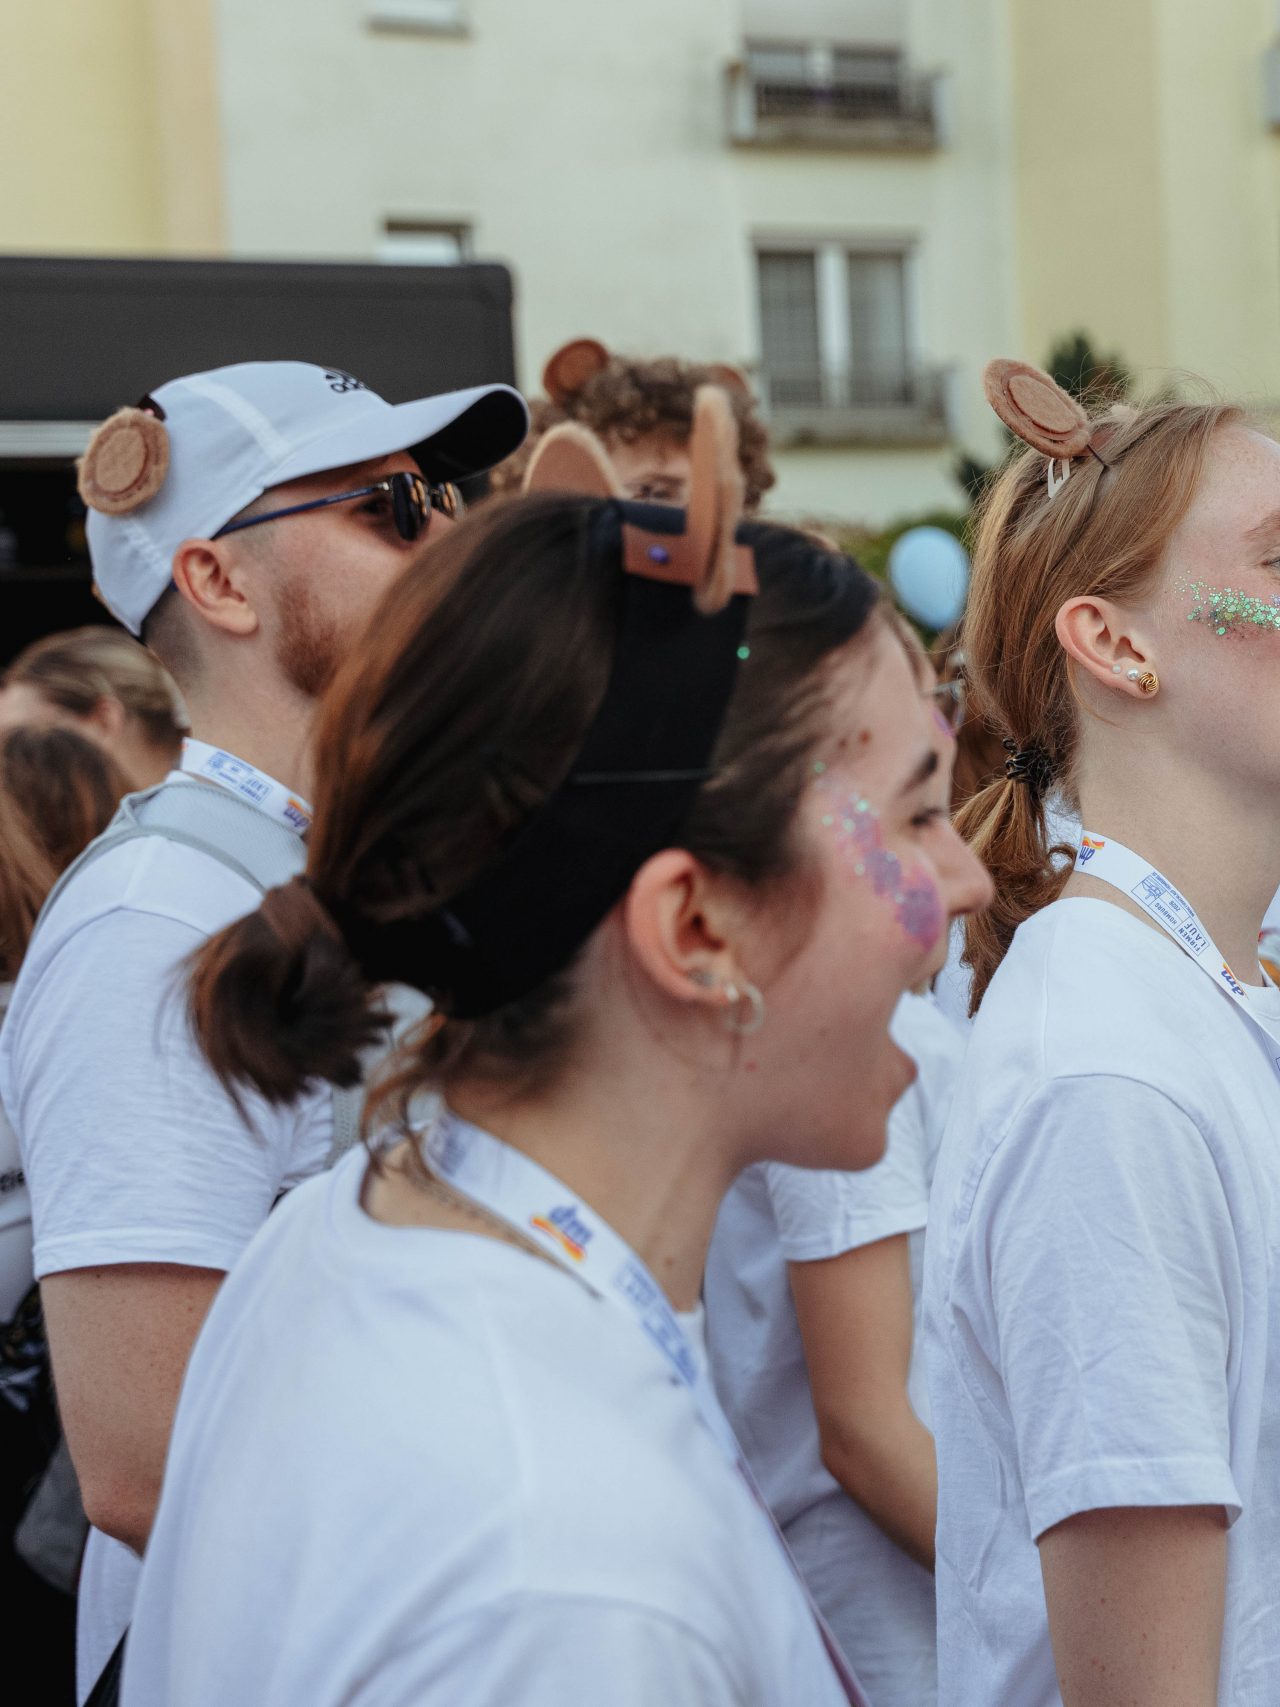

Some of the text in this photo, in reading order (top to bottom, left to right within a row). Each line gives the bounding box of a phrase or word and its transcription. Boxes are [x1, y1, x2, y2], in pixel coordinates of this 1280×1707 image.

[1178, 927, 1201, 952] FIRMEN
[1184, 923, 1207, 947] LAUF
[1221, 969, 1245, 996] dm
